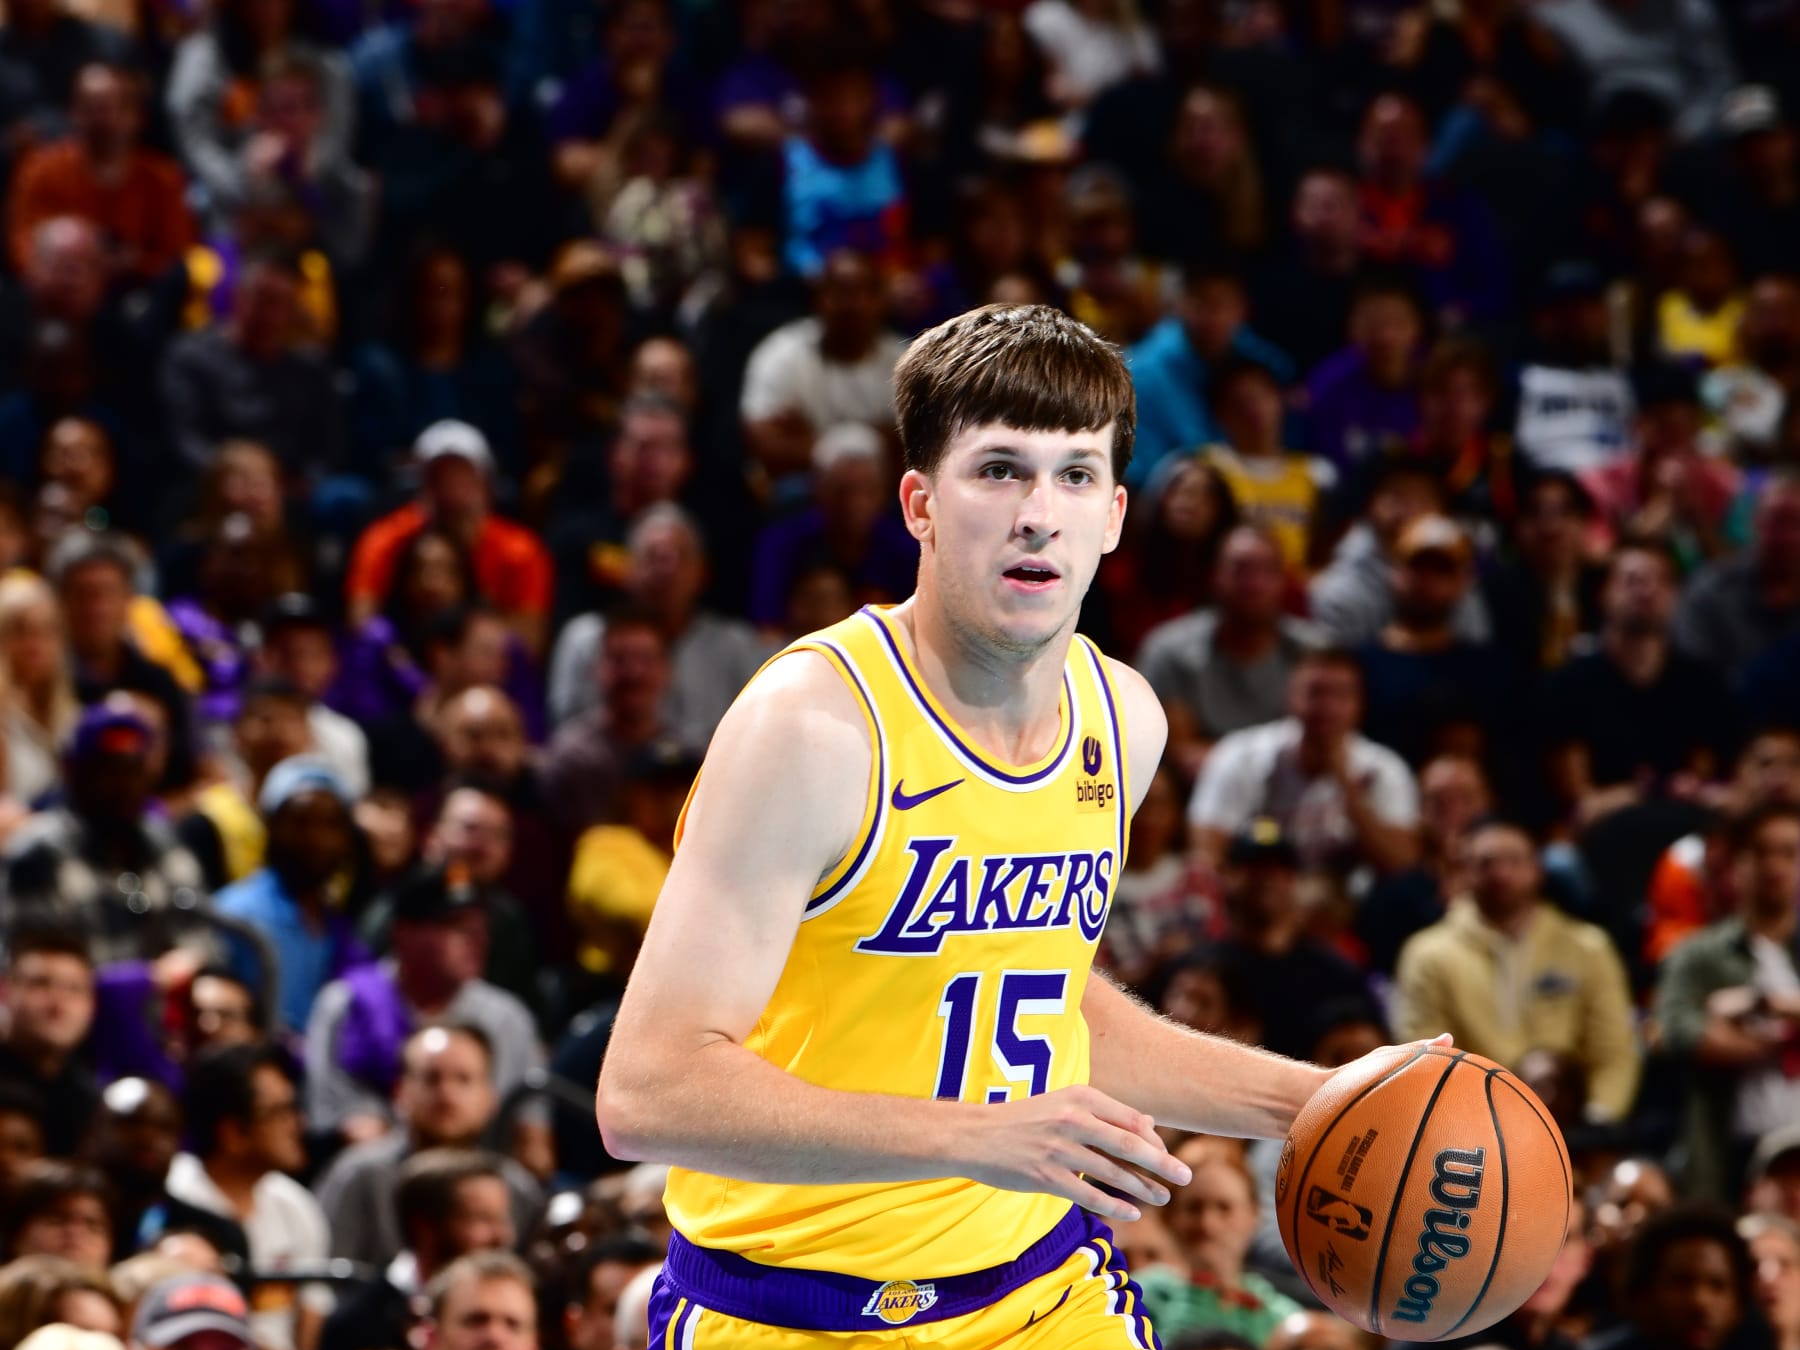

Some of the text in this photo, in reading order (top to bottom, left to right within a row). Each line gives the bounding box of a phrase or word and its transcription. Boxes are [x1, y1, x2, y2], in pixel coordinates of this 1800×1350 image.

[1076, 779, 1114, 808] bibigo
[852, 835, 1114, 957] LAKERS
[932, 968, 1071, 1105] 15
[1391, 1146, 1487, 1324] Wilson
[861, 1289, 937, 1315] LAKERS
